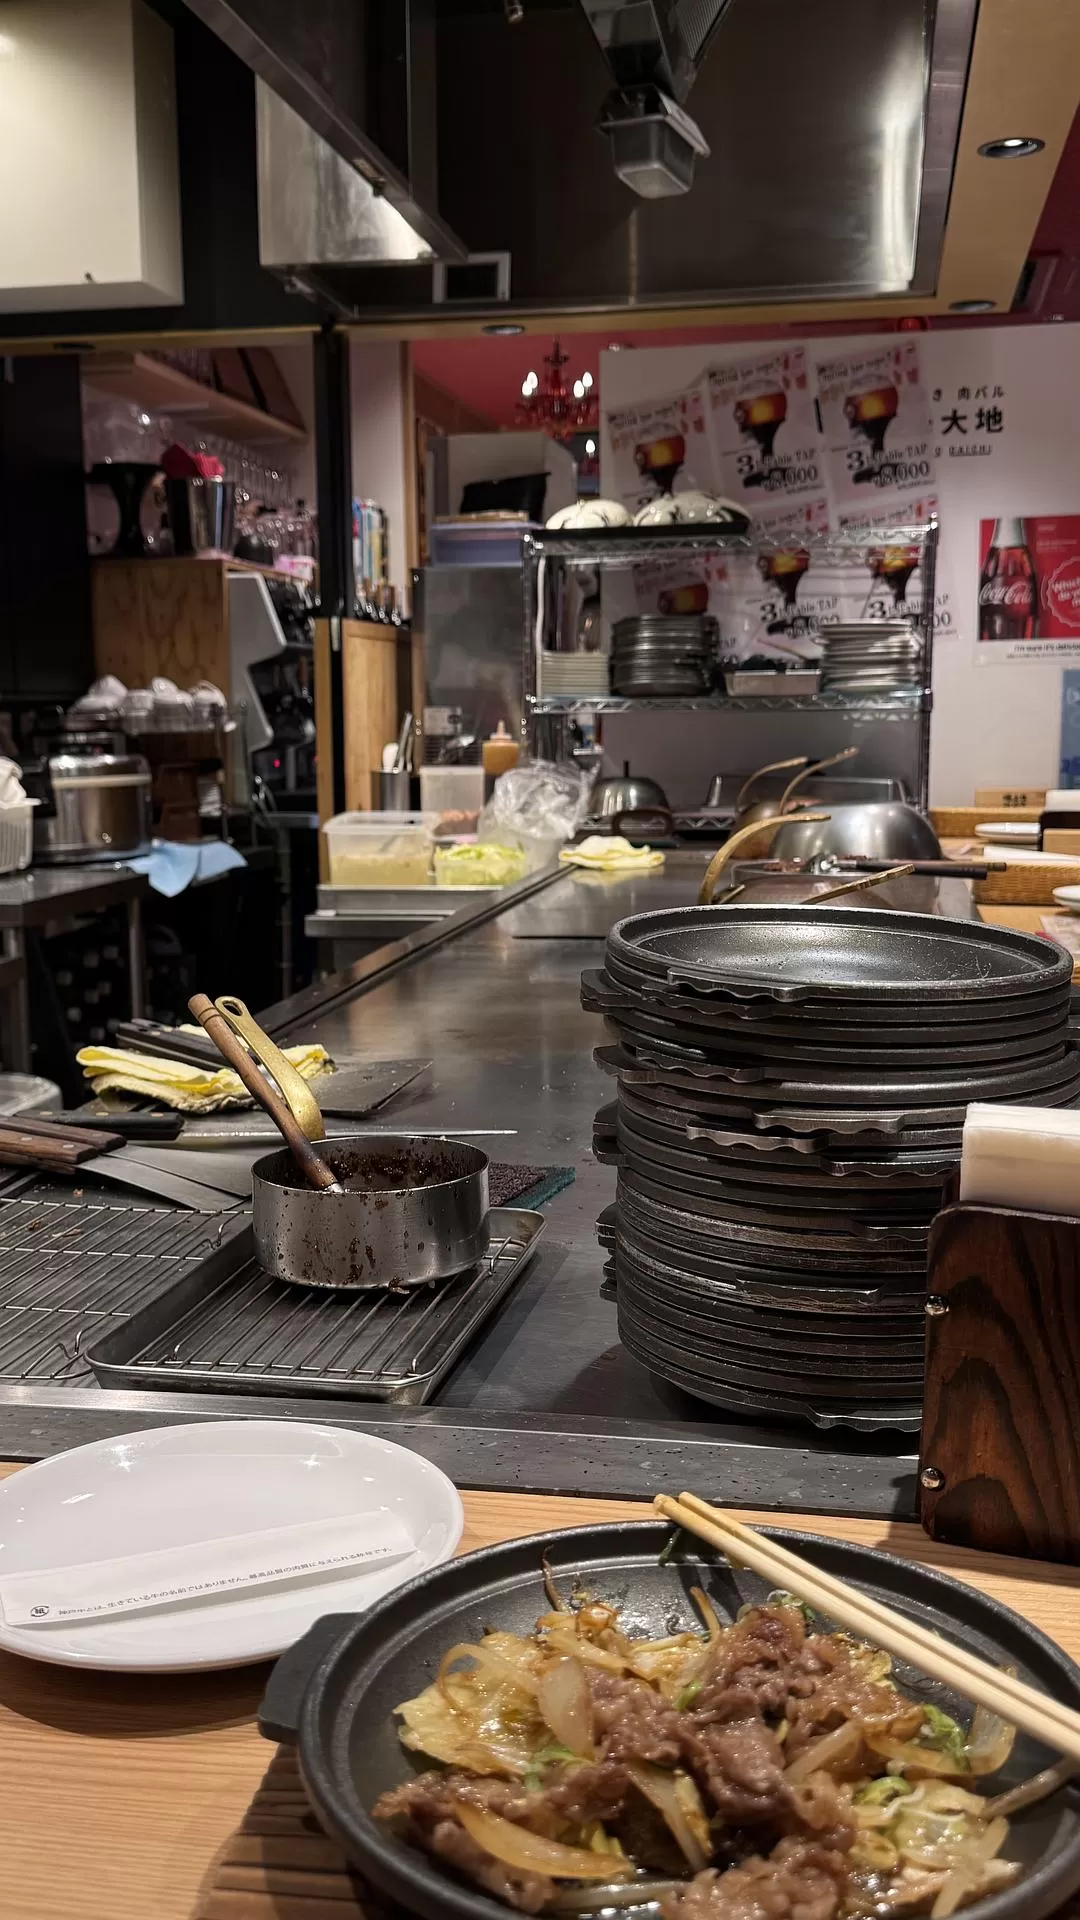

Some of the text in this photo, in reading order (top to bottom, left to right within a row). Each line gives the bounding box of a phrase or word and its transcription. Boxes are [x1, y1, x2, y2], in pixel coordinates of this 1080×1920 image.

[957, 385, 1005, 401] 肉バル
[940, 405, 1005, 435] 大地
